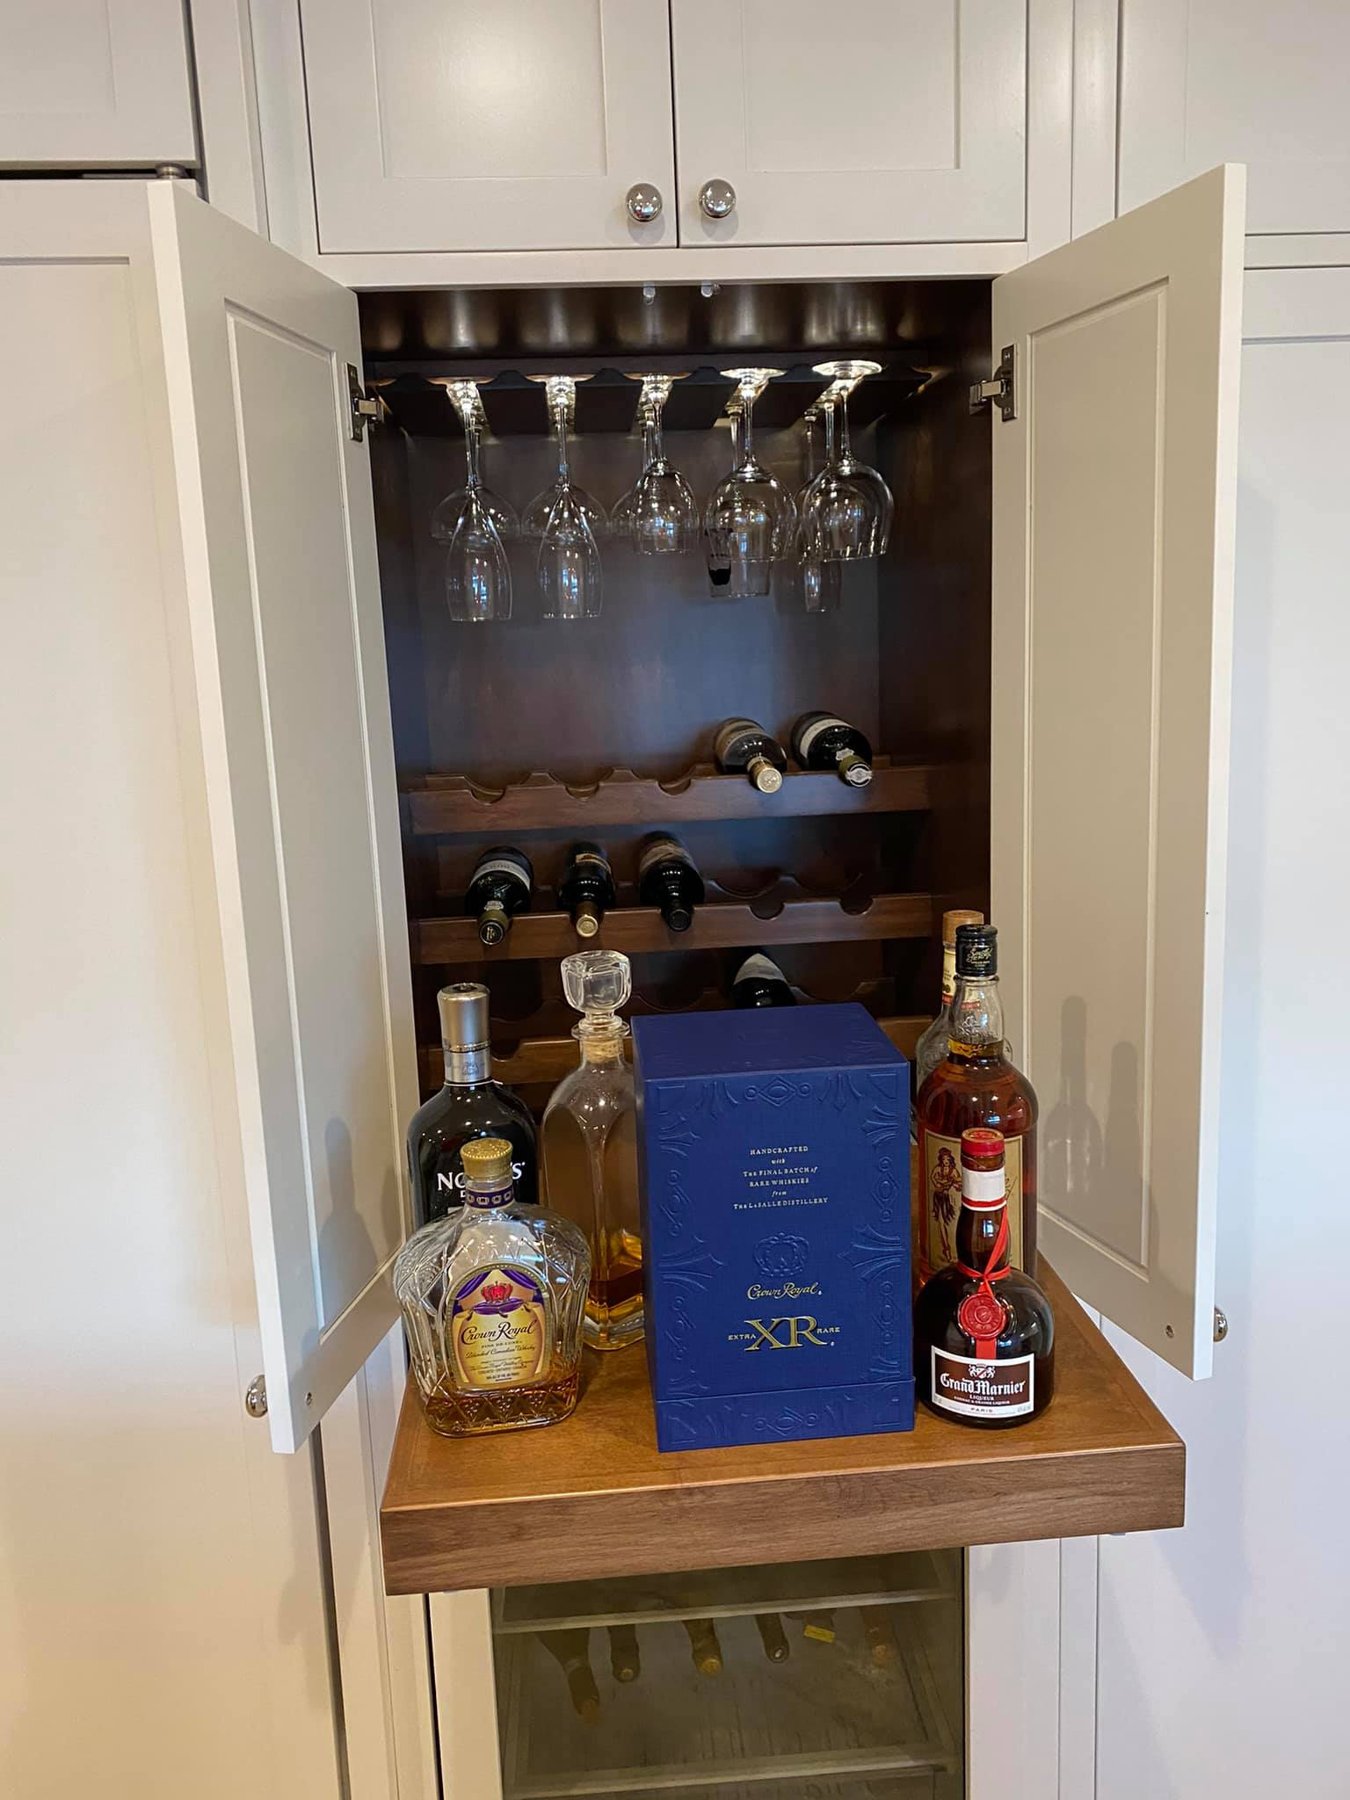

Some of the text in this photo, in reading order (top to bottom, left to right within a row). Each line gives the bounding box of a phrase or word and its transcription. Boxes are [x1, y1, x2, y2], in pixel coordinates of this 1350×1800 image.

[750, 1146, 808, 1156] HANDCRAFTED
[437, 1161, 520, 1191] NO'S
[759, 1169, 782, 1177] FINAL
[784, 1167, 809, 1175] BATCH
[810, 1166, 819, 1174] of
[749, 1177, 809, 1188] RARE WHISKIES
[771, 1190, 787, 1198] from
[782, 1197, 829, 1207] DISTILLERY
[747, 1282, 819, 1300] Crown Royal
[460, 1320, 538, 1345] Crown Royal
[728, 1315, 840, 1351] EXTRA XR RARE
[940, 1373, 1026, 1396] Grand Marnier
